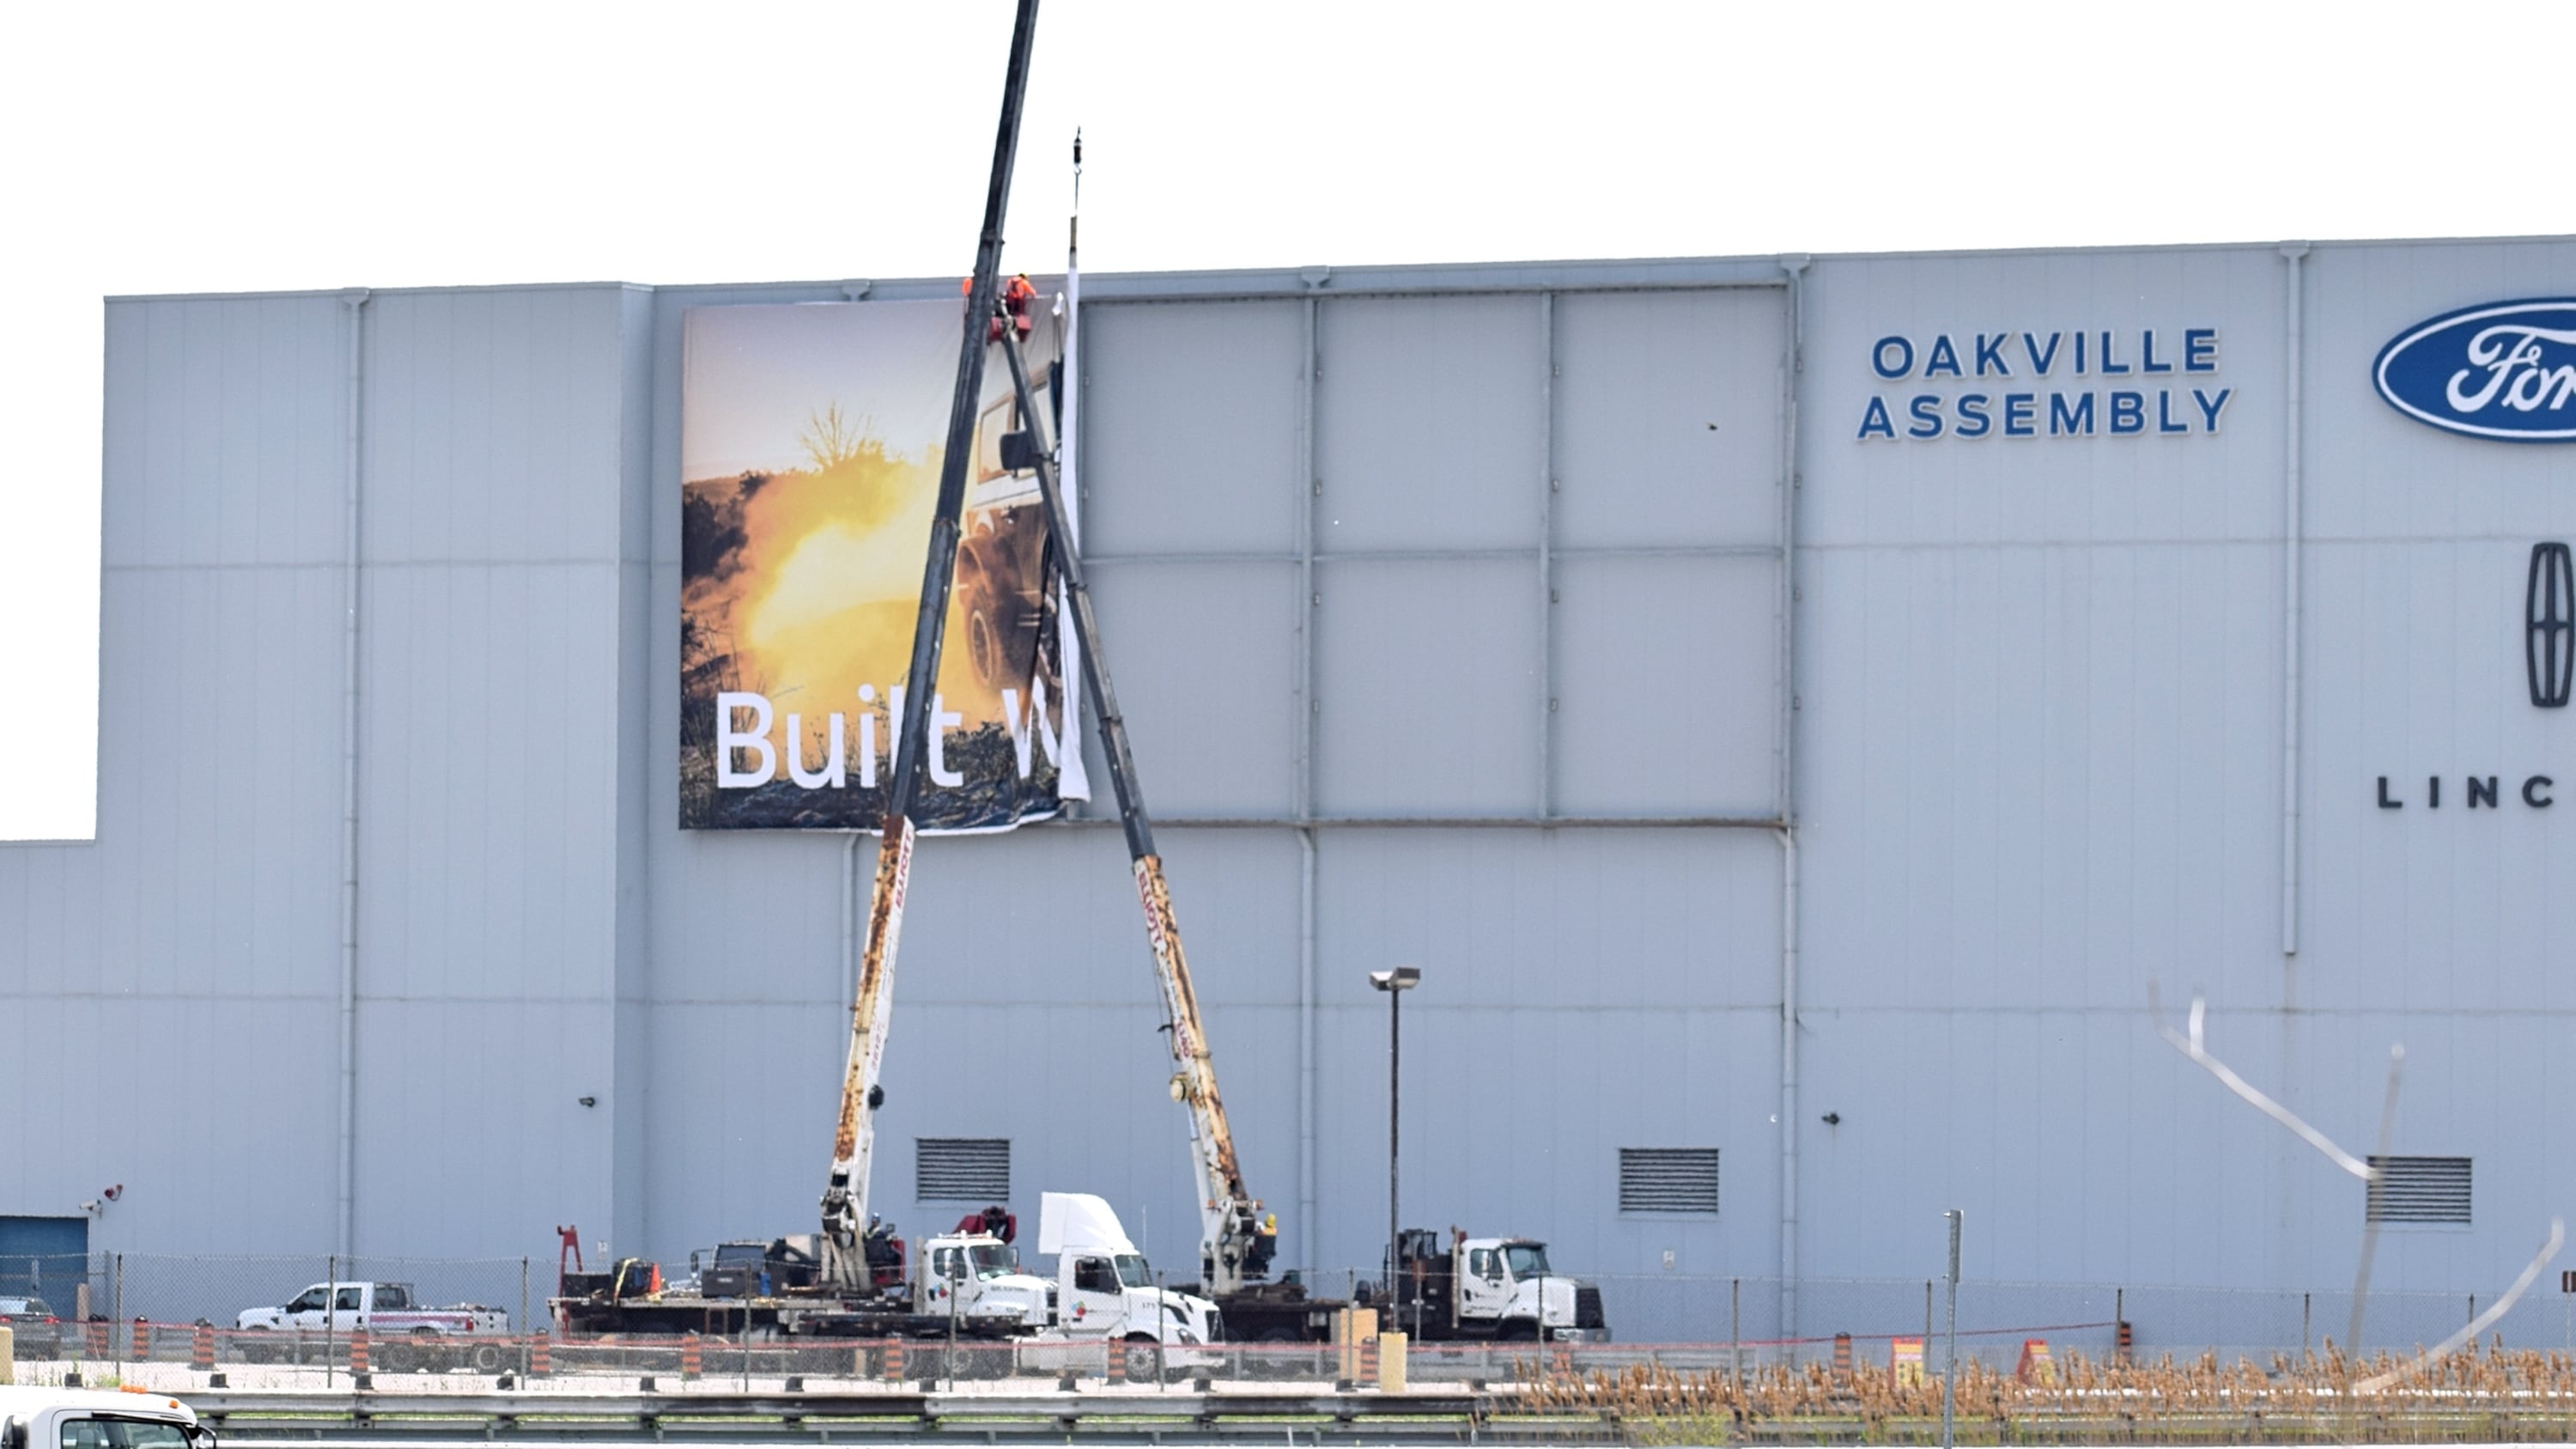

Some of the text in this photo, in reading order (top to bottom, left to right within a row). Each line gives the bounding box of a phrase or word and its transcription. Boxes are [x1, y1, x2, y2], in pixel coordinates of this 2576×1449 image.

[1871, 329, 2217, 379] OAKVILLE
[1856, 389, 2231, 439] ASSEMBLY
[717, 684, 963, 789] Built
[2377, 775, 2555, 809] LINC
[1139, 870, 1162, 943] ELLIOTT
